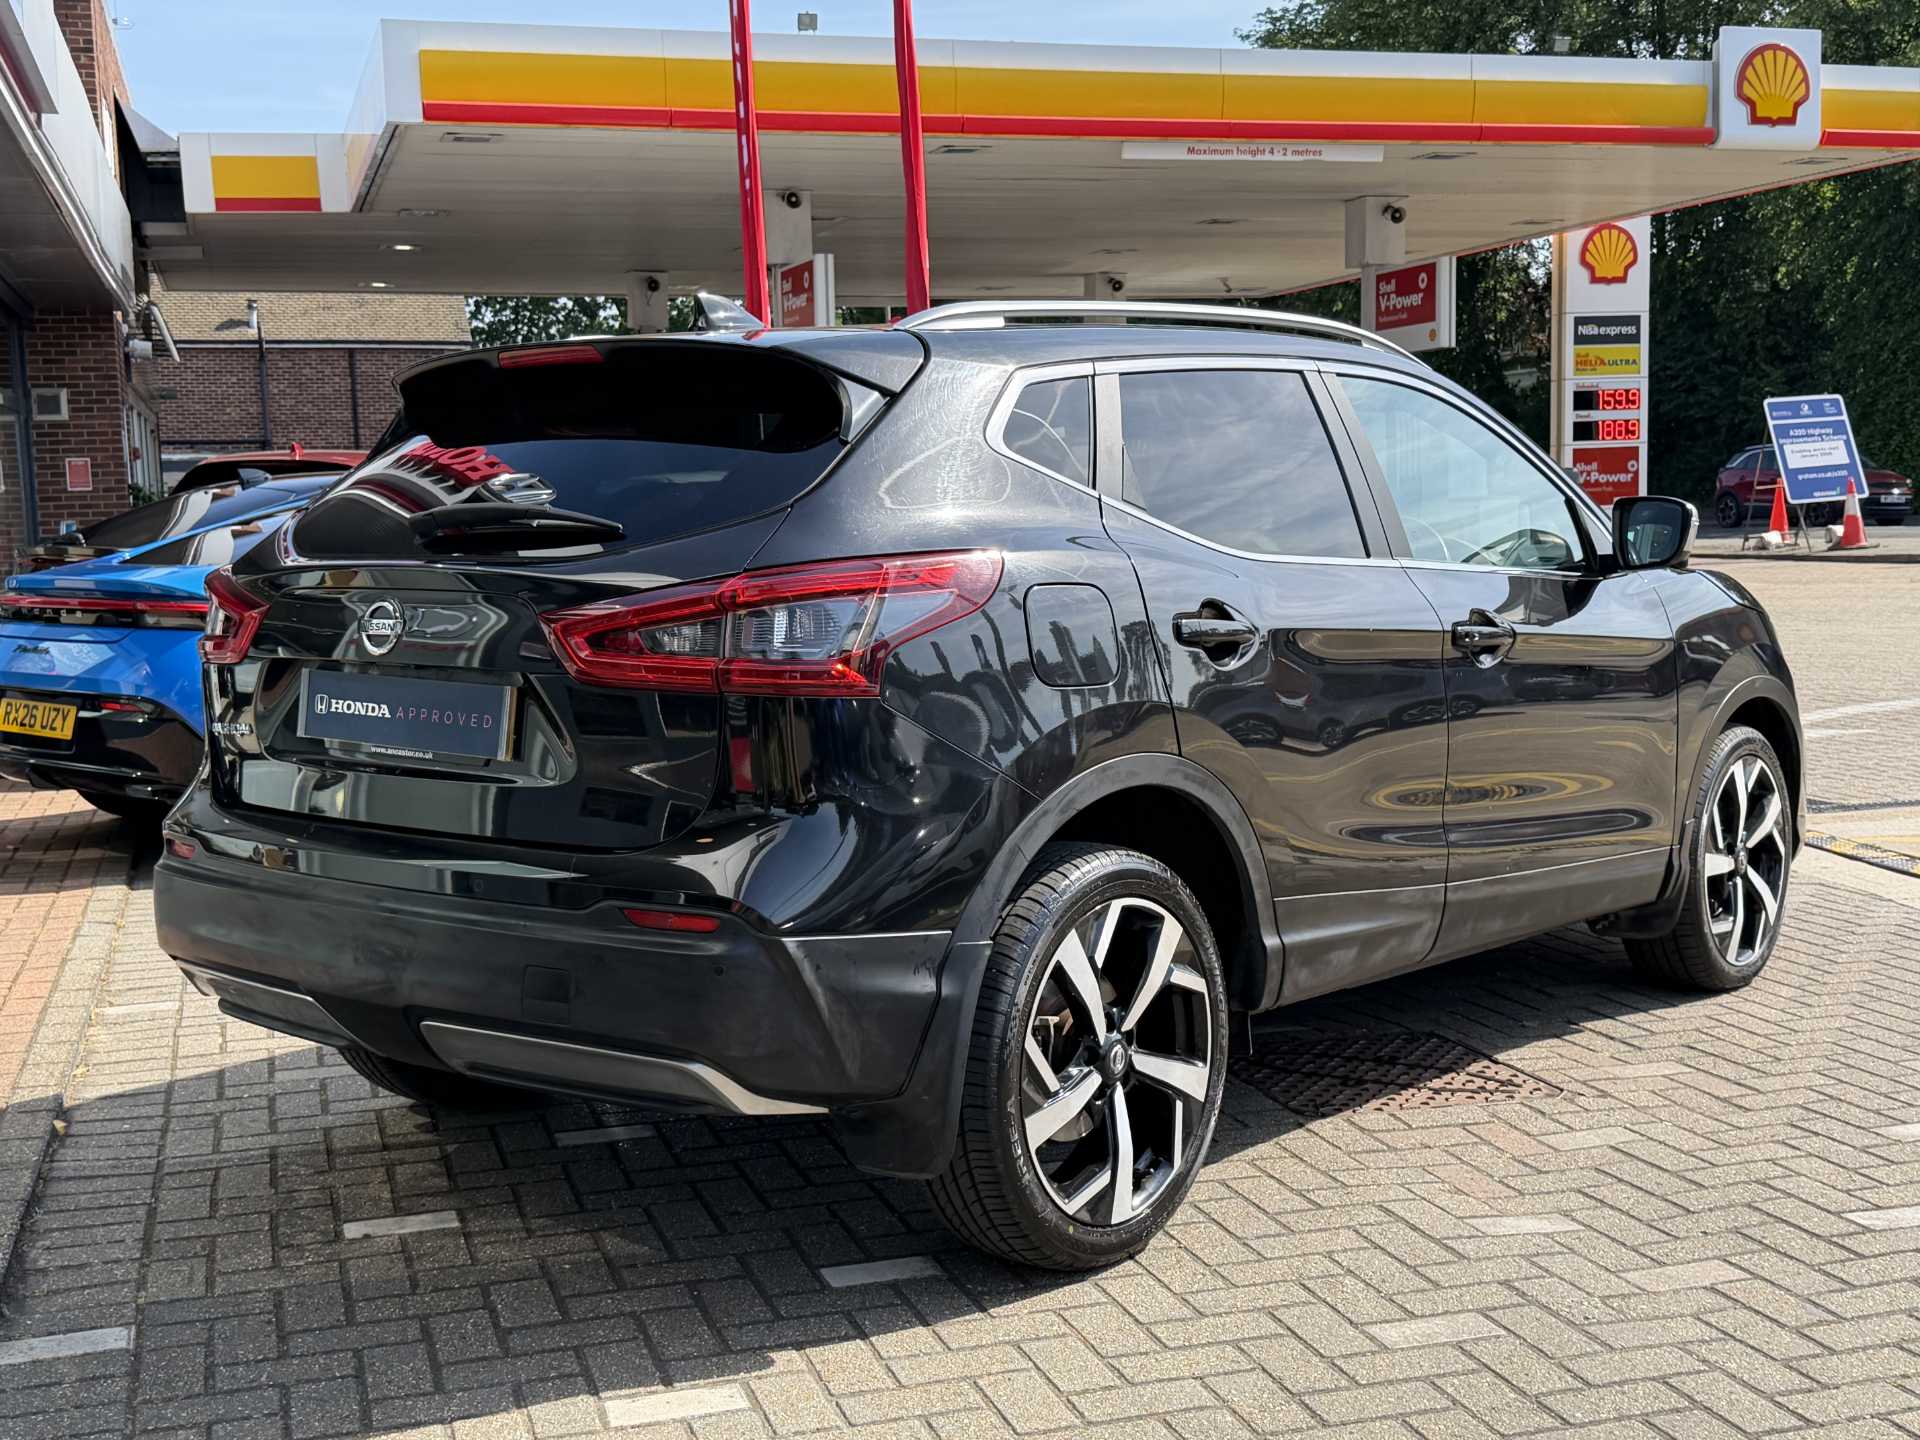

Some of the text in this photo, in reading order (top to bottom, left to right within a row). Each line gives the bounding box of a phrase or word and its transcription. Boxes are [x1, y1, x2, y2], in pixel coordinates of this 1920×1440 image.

[1186, 146, 1234, 156] Maximum
[1236, 147, 1266, 158] height
[1291, 149, 1323, 158] metres
[1379, 279, 1396, 294] Shell
[1607, 359, 1638, 367] ULTRA
[1598, 389, 1640, 410] 159.9
[1598, 420, 1639, 441] 188.9
[2, 702, 71, 733] RX26 UZY
[330, 698, 492, 729] HONDA APPROVED
[370, 744, 433, 760] www.ancaster.co.uk
